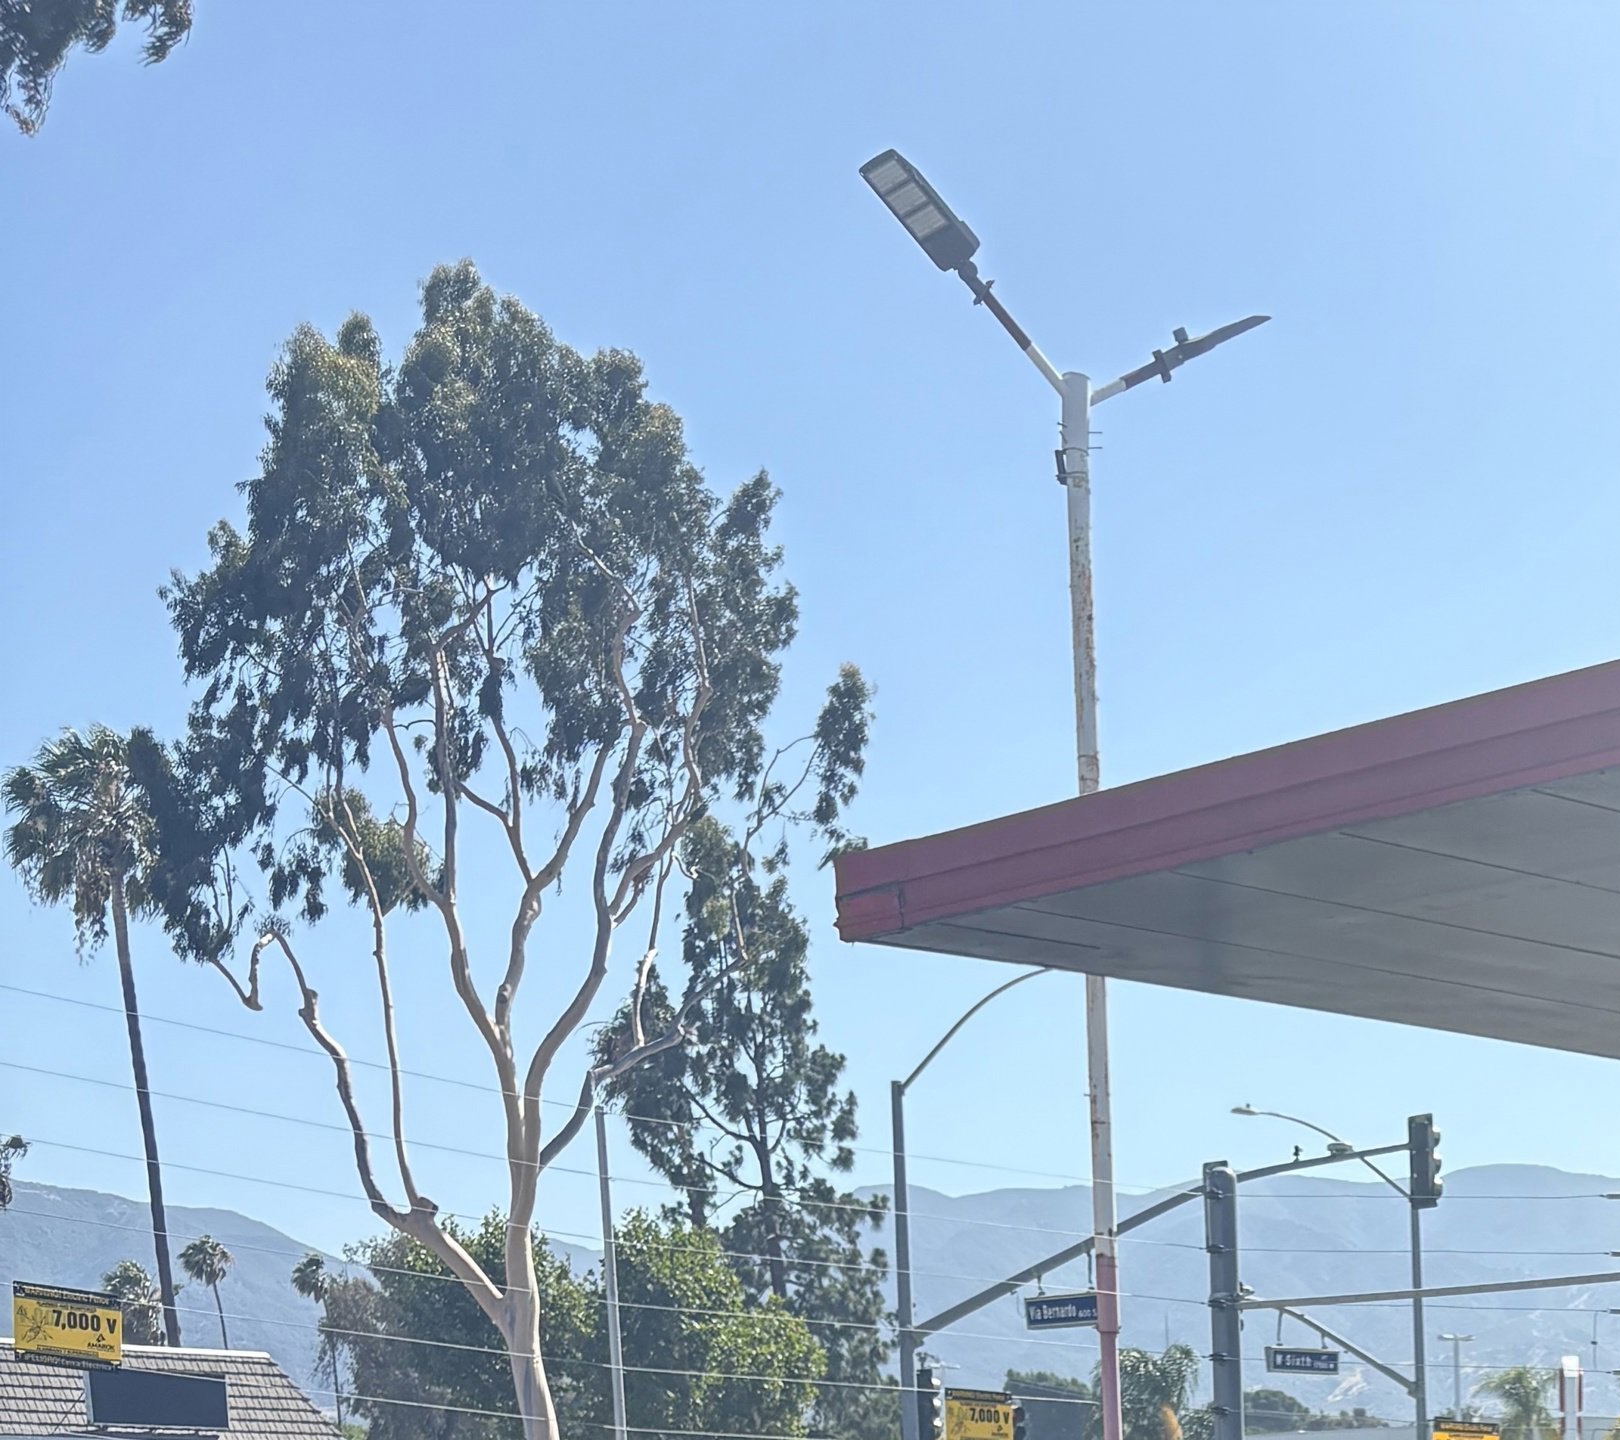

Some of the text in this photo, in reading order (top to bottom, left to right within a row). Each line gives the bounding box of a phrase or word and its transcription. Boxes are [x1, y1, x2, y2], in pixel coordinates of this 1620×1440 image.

[1029, 1306, 1042, 1320] Via
[1043, 1303, 1076, 1319] Bernardo
[53, 1309, 117, 1334] 7,000 V
[969, 1408, 1010, 1424] 7,000 V
